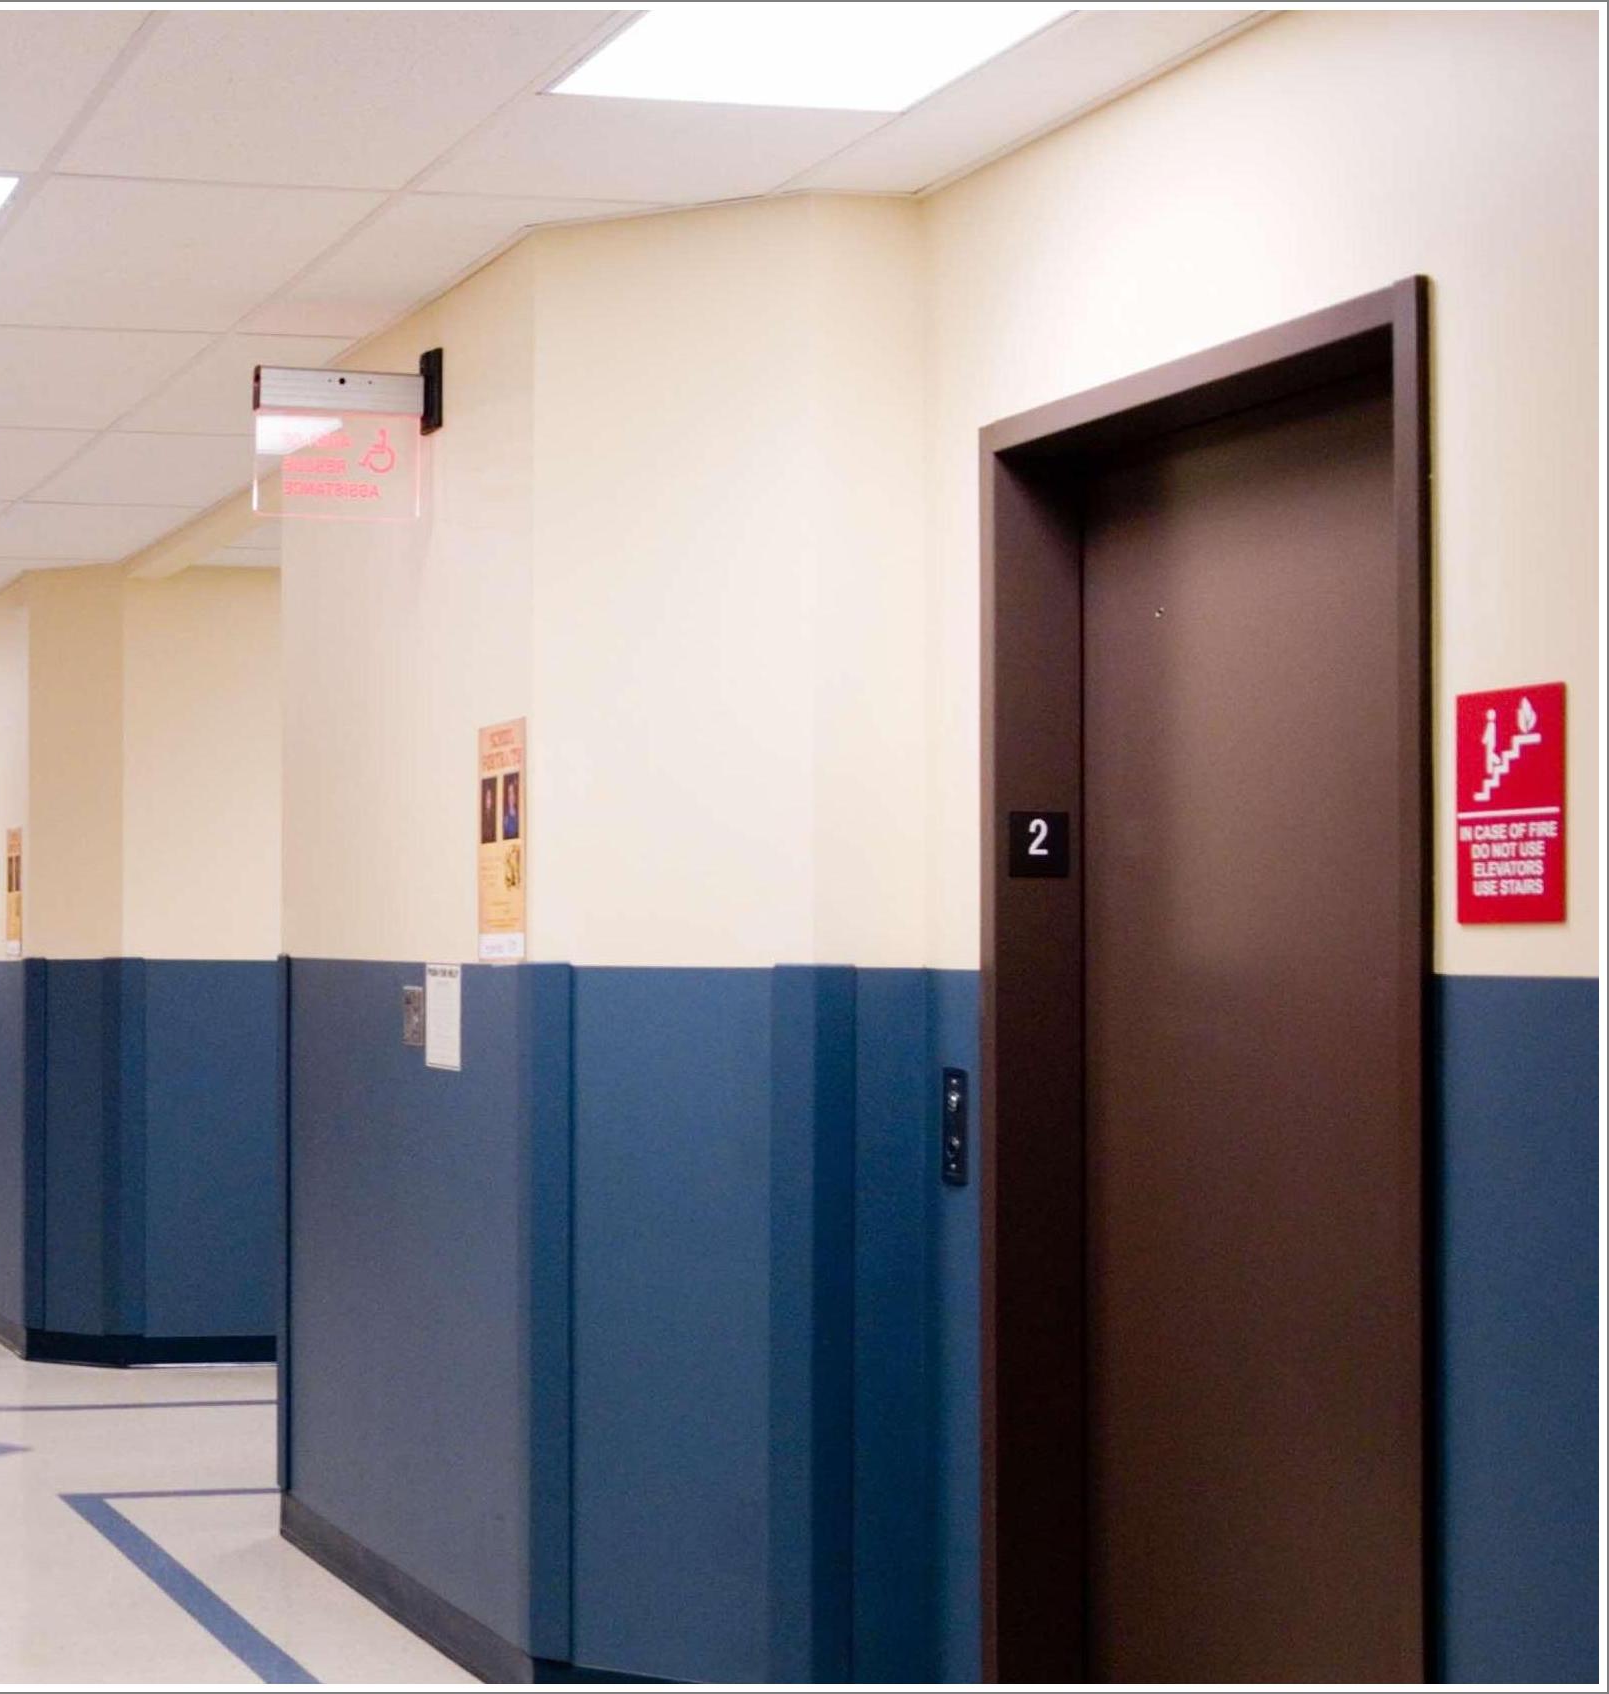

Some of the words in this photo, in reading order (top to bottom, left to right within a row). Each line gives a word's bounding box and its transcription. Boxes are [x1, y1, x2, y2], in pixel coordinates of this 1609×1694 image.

[1028, 818, 1049, 855] 2
[1460, 825, 1473, 841] IN
[1474, 825, 1507, 840] CASE
[1509, 823, 1527, 838] OF
[1529, 821, 1558, 837] FIRE
[1472, 844, 1490, 859] DO
[1491, 841, 1518, 858] NOT
[1519, 840, 1545, 857] USE
[1473, 860, 1543, 877] ELEVATORS
[1473, 880, 1498, 896] USE
[1500, 879, 1543, 895] STAIRS
